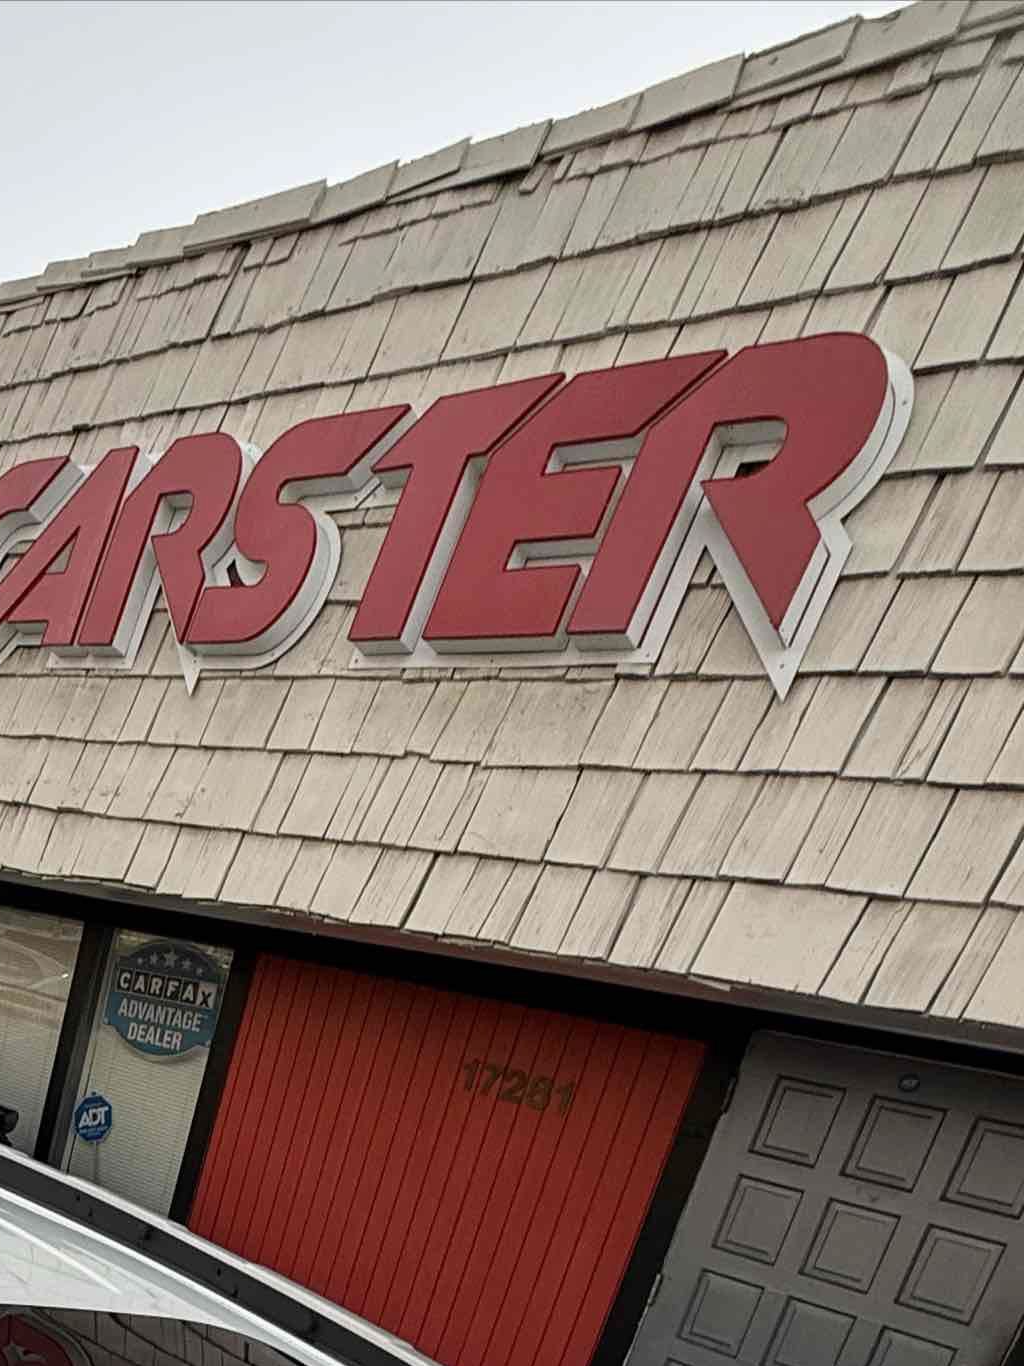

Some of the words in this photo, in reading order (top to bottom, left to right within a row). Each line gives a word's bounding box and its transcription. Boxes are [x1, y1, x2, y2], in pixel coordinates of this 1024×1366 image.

[118, 971, 216, 1009] CARFAX
[117, 998, 203, 1033] ADVANTAGE
[127, 1023, 183, 1050] DEALER
[463, 1057, 577, 1120] 17281
[78, 1106, 109, 1128] ADT
